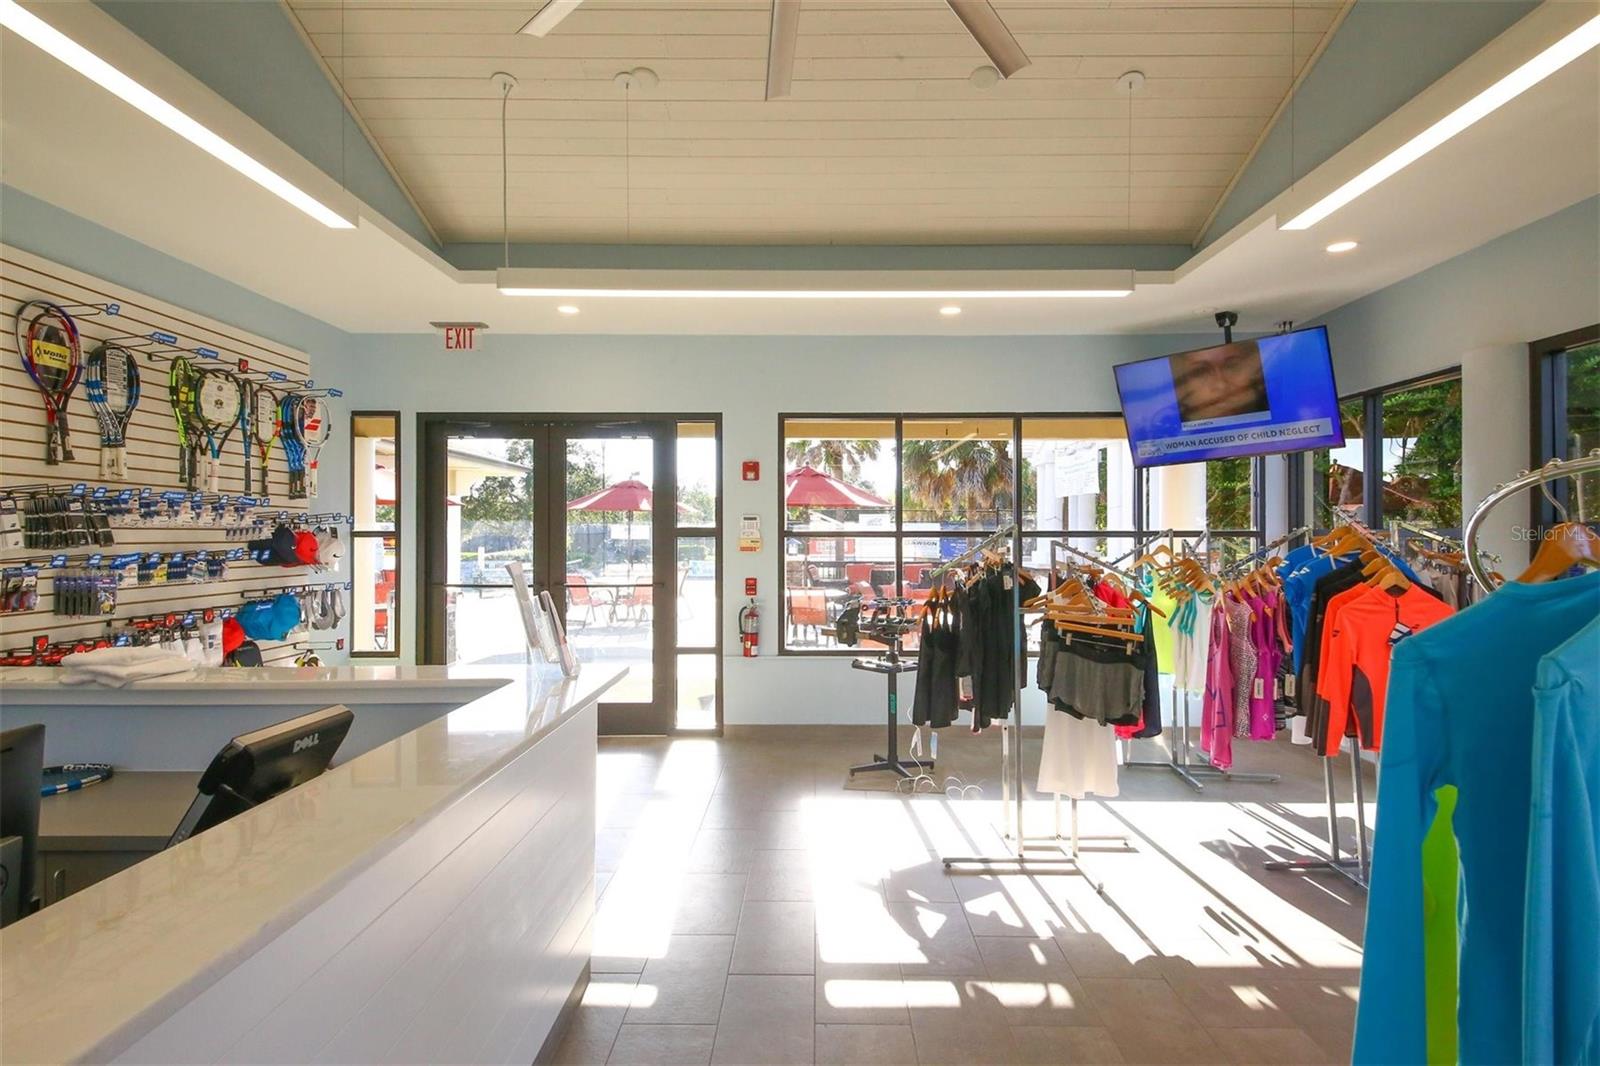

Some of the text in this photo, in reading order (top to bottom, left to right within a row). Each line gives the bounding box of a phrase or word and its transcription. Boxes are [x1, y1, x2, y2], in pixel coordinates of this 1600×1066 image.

[446, 327, 475, 349] EXIT
[1165, 439, 1197, 450] WOMAN
[1198, 435, 1236, 446] ACCUSED
[1237, 433, 1249, 442] OF
[1251, 430, 1278, 440] CHILD
[1279, 424, 1320, 437] NEGLECT
[293, 732, 320, 753] DELL
